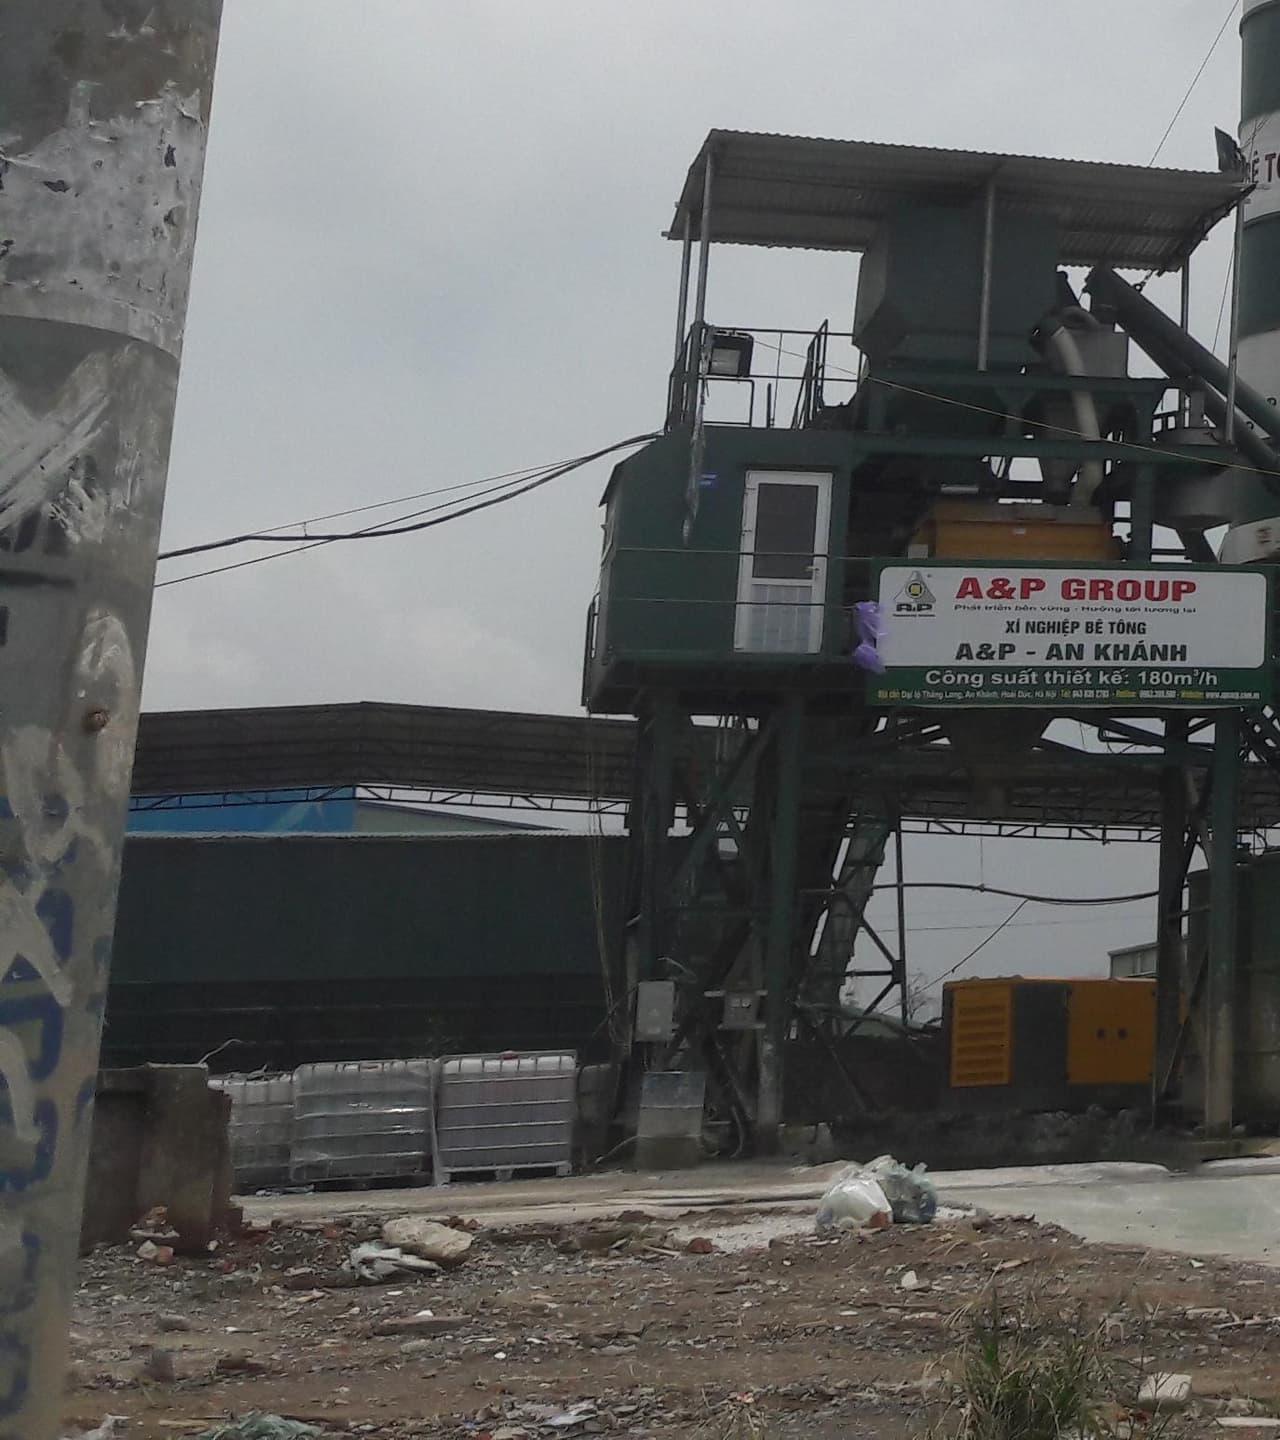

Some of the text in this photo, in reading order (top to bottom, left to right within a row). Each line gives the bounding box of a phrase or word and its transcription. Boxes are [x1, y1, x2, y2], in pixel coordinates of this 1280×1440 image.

[955, 577, 1197, 602] A&P GROUP
[1005, 618, 1147, 637] XÍ NGHIỆP BÊ TÔNG
[955, 643, 1016, 661] A&P
[1045, 643, 1084, 661] AN
[1094, 640, 1188, 662] KHÁNH
[925, 669, 984, 688] Công
[991, 668, 1038, 685] suất
[1044, 669, 1092, 685] thiết
